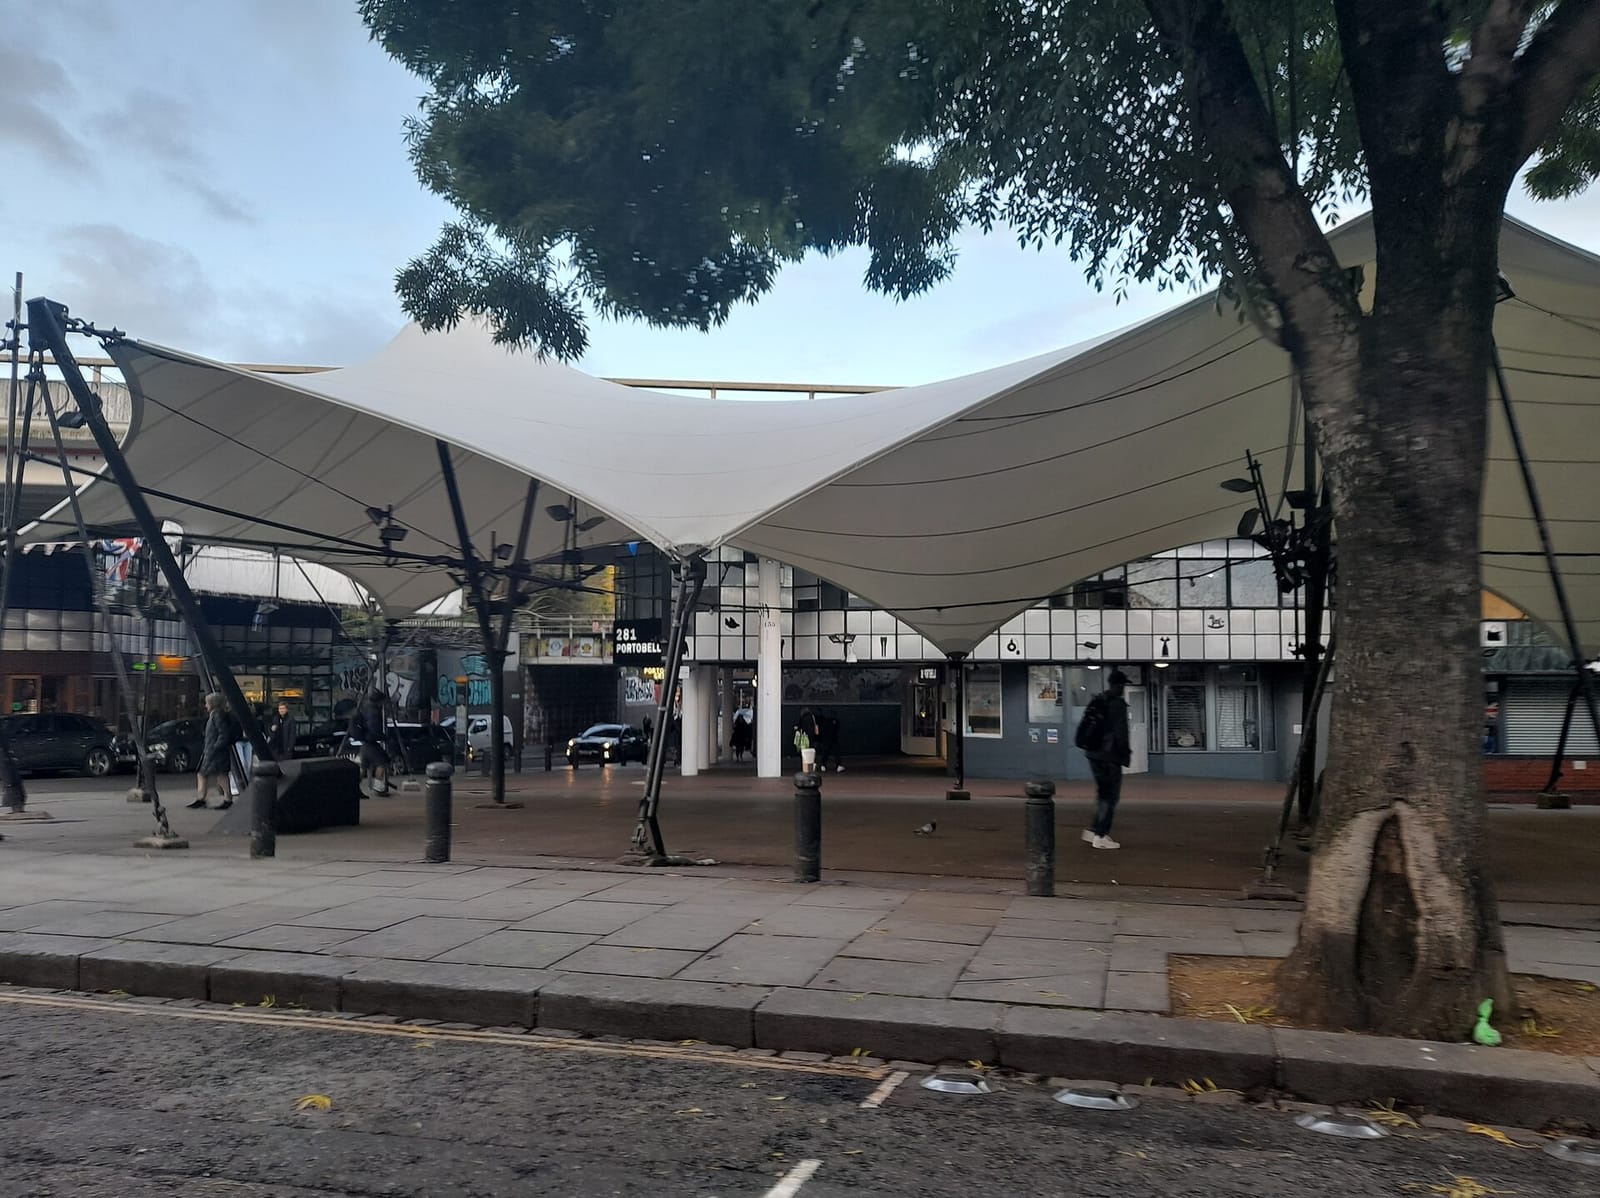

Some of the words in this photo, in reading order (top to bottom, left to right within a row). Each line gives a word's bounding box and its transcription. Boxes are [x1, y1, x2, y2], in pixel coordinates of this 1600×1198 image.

[615, 627, 637, 641] 281
[615, 642, 662, 654] PORTOBELL
[643, 667, 665, 675] PORTO
